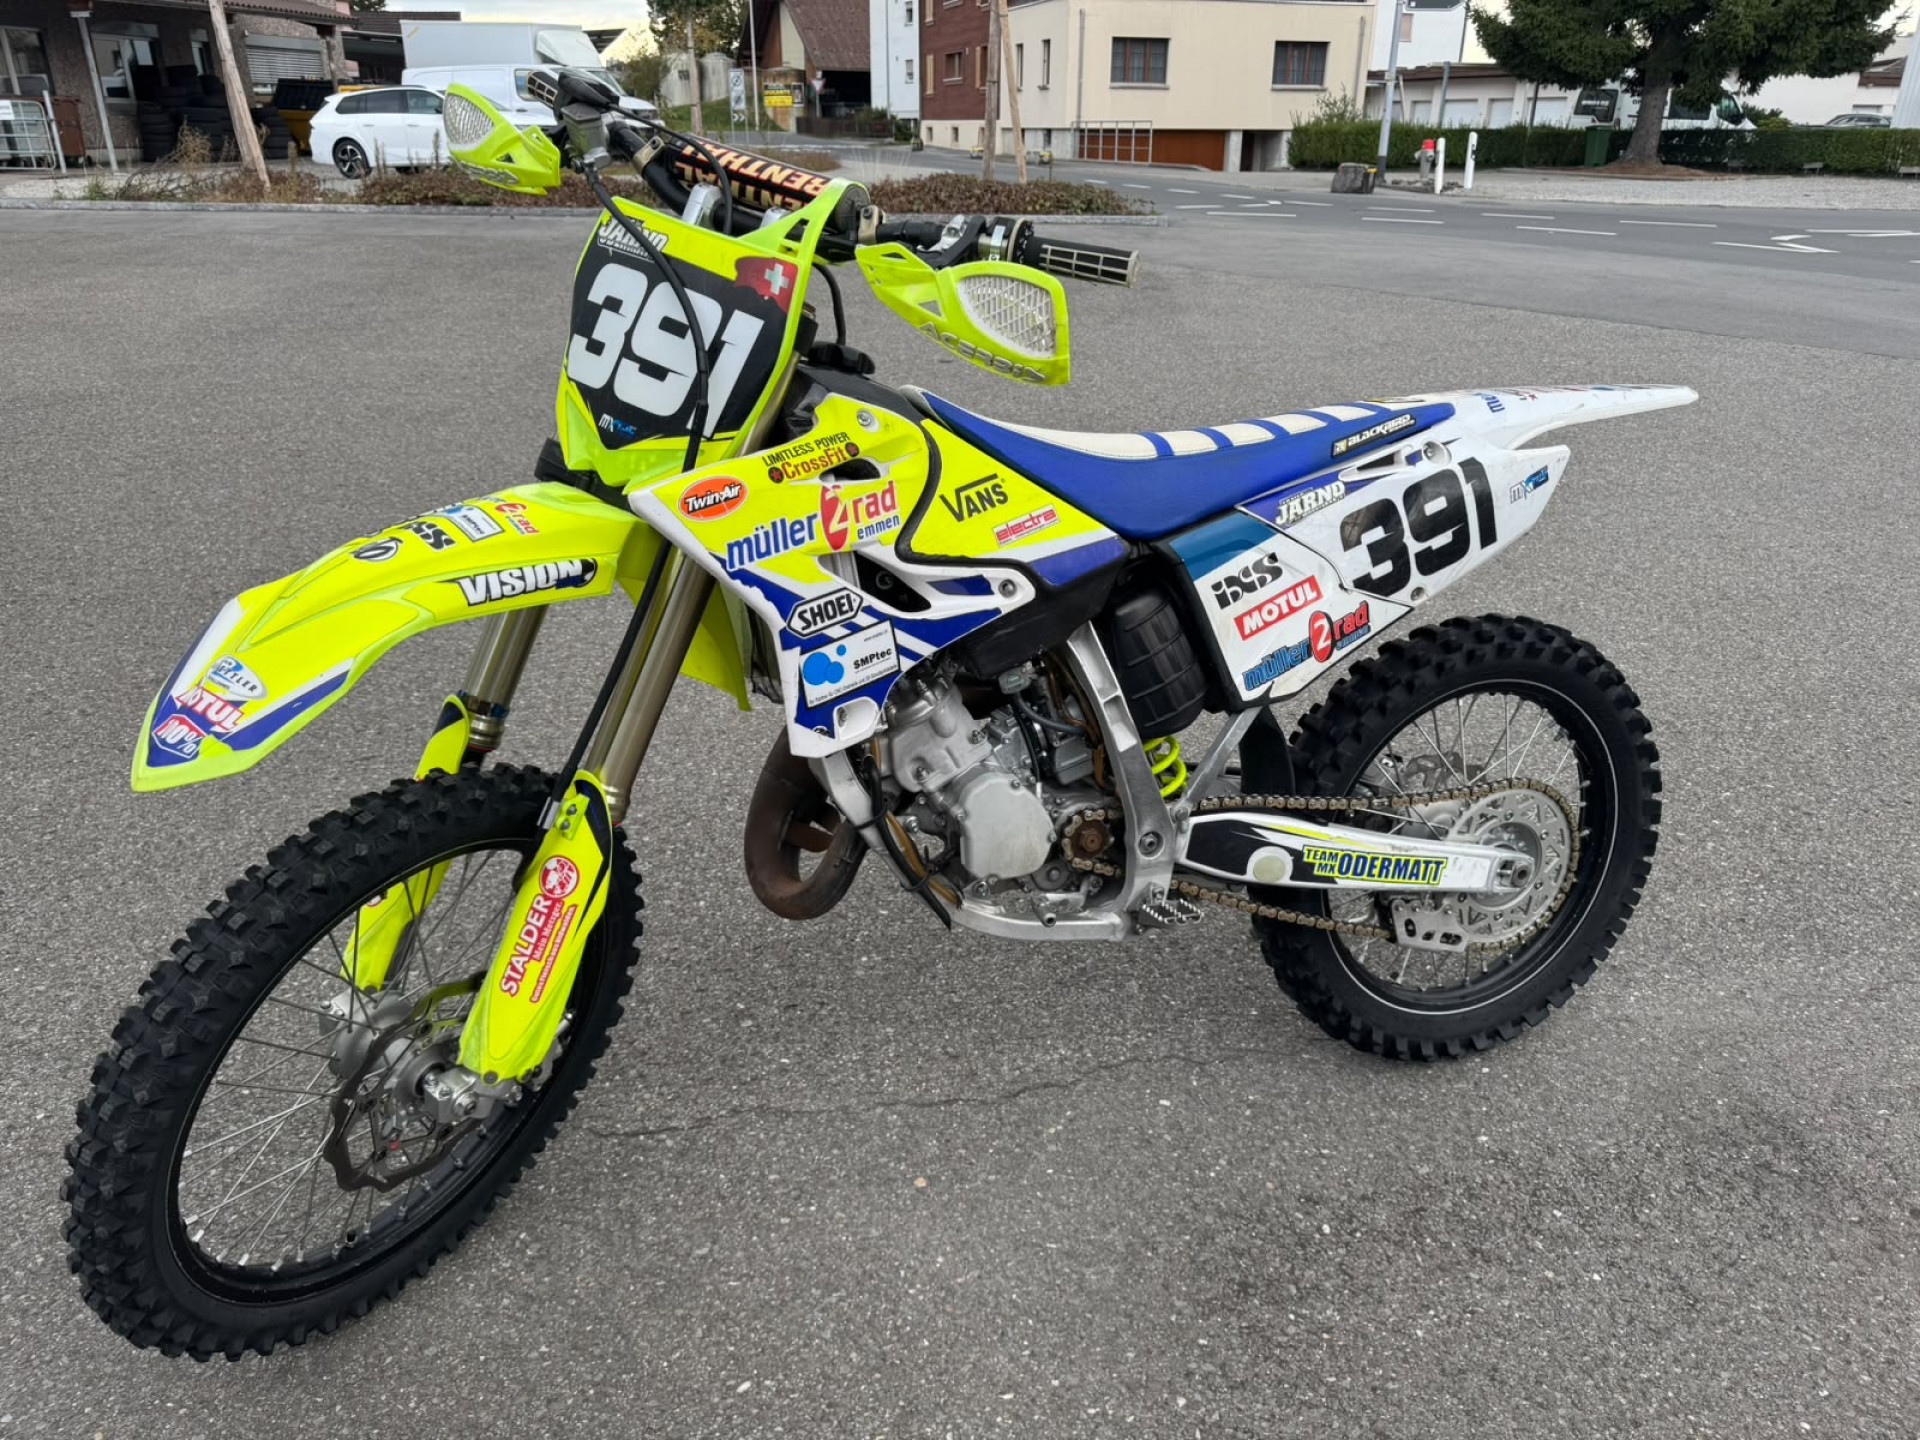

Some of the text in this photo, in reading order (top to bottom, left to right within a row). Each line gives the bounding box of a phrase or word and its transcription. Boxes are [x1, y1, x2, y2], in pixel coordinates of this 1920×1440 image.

[567, 262, 766, 440] 391
[762, 431, 850, 466] LIMITLESS POWER
[781, 446, 847, 480] CrossFit
[939, 472, 1009, 522] VANS
[727, 511, 818, 569] müller
[857, 514, 900, 540] emmen
[1339, 456, 1498, 599] 391
[456, 558, 584, 605] VISION
[797, 592, 855, 632] SHOEI
[1242, 581, 1318, 636] MOTUL
[852, 648, 893, 670] SMPtec
[1241, 638, 1314, 692] müller
[1305, 848, 1338, 863] TEAM
[1317, 862, 1338, 875] MX
[1338, 852, 1445, 882] ODERMATT
[500, 895, 553, 996] STALDER
